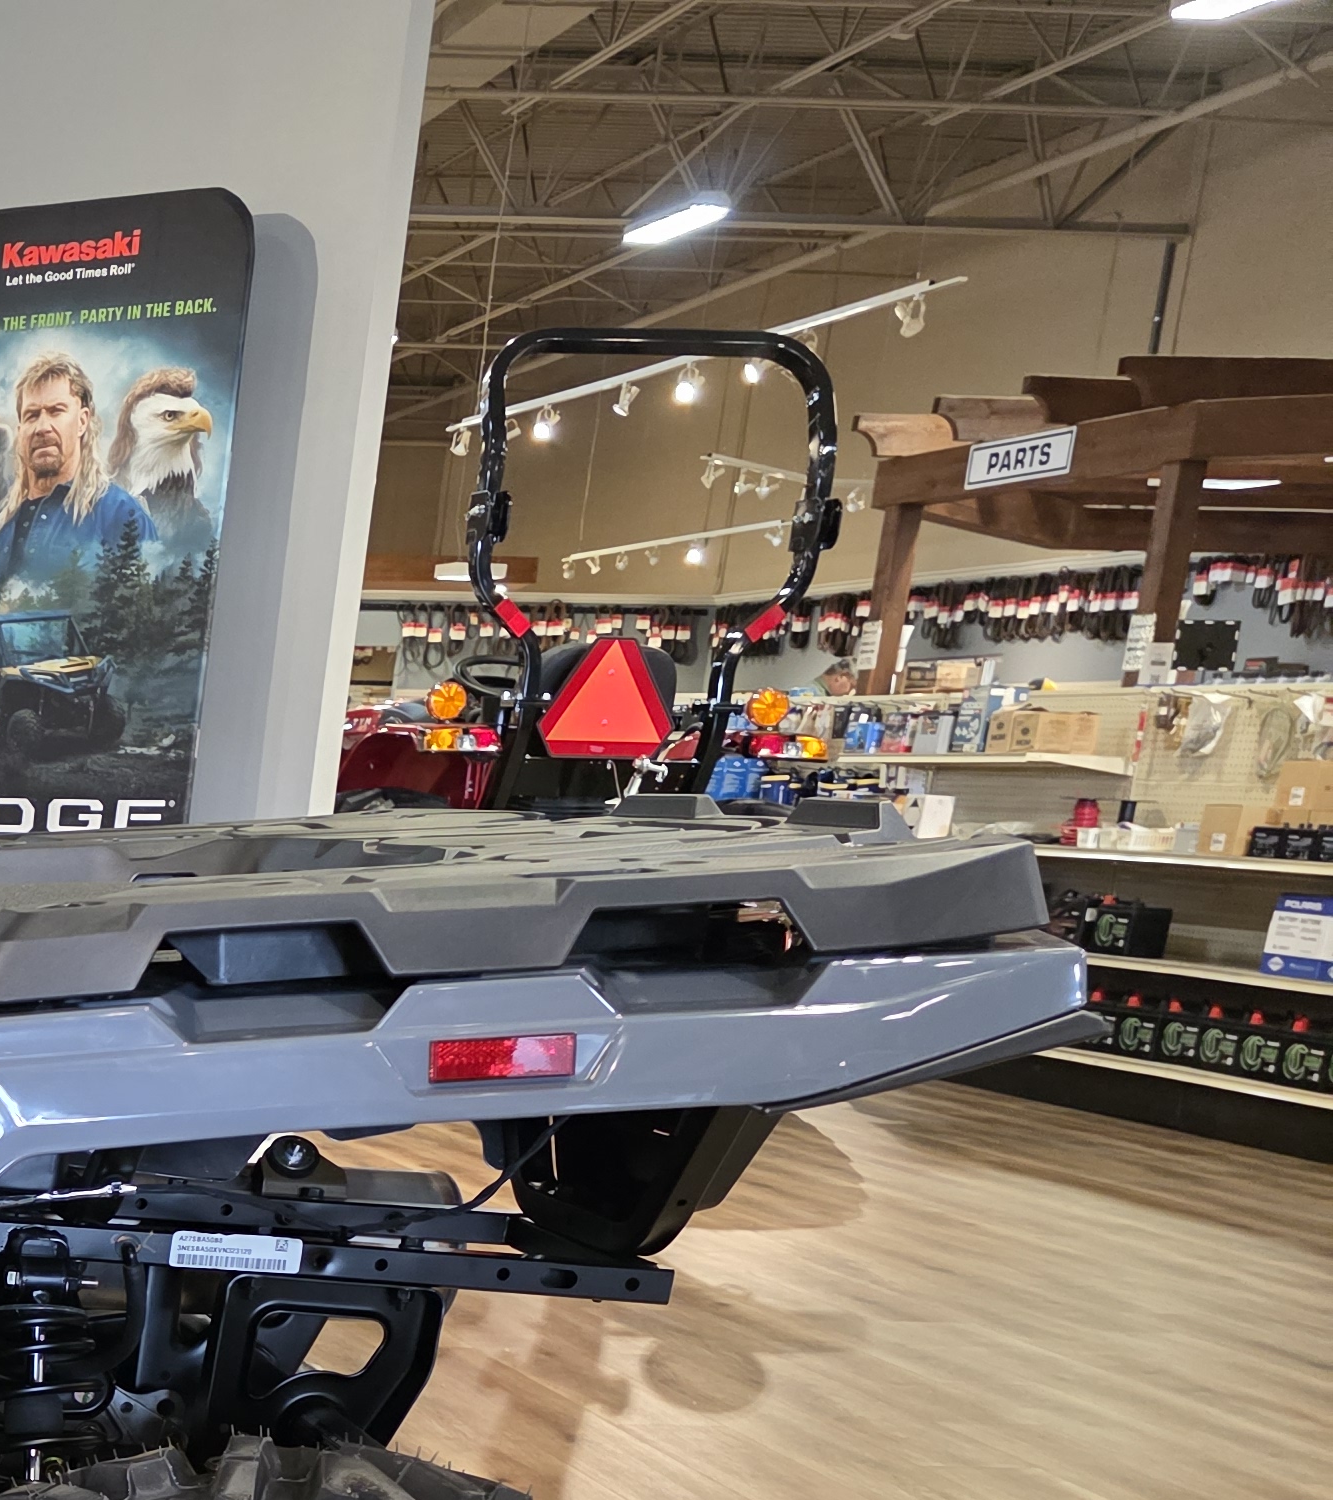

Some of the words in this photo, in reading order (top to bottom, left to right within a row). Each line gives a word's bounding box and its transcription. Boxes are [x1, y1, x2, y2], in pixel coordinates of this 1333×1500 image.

[2, 229, 141, 269] Kawasaki
[6, 274, 22, 286] Let
[26, 273, 42, 284] the
[45, 269, 73, 282] Good
[75, 266, 107, 279] Times
[3, 315, 27, 332] THE
[30, 311, 75, 329] FRONT.
[79, 307, 123, 324] PARTY
[127, 305, 142, 319] IN
[146, 302, 171, 317] THE
[175, 298, 217, 315] BACK.
[987, 443, 1052, 475] PARTS
